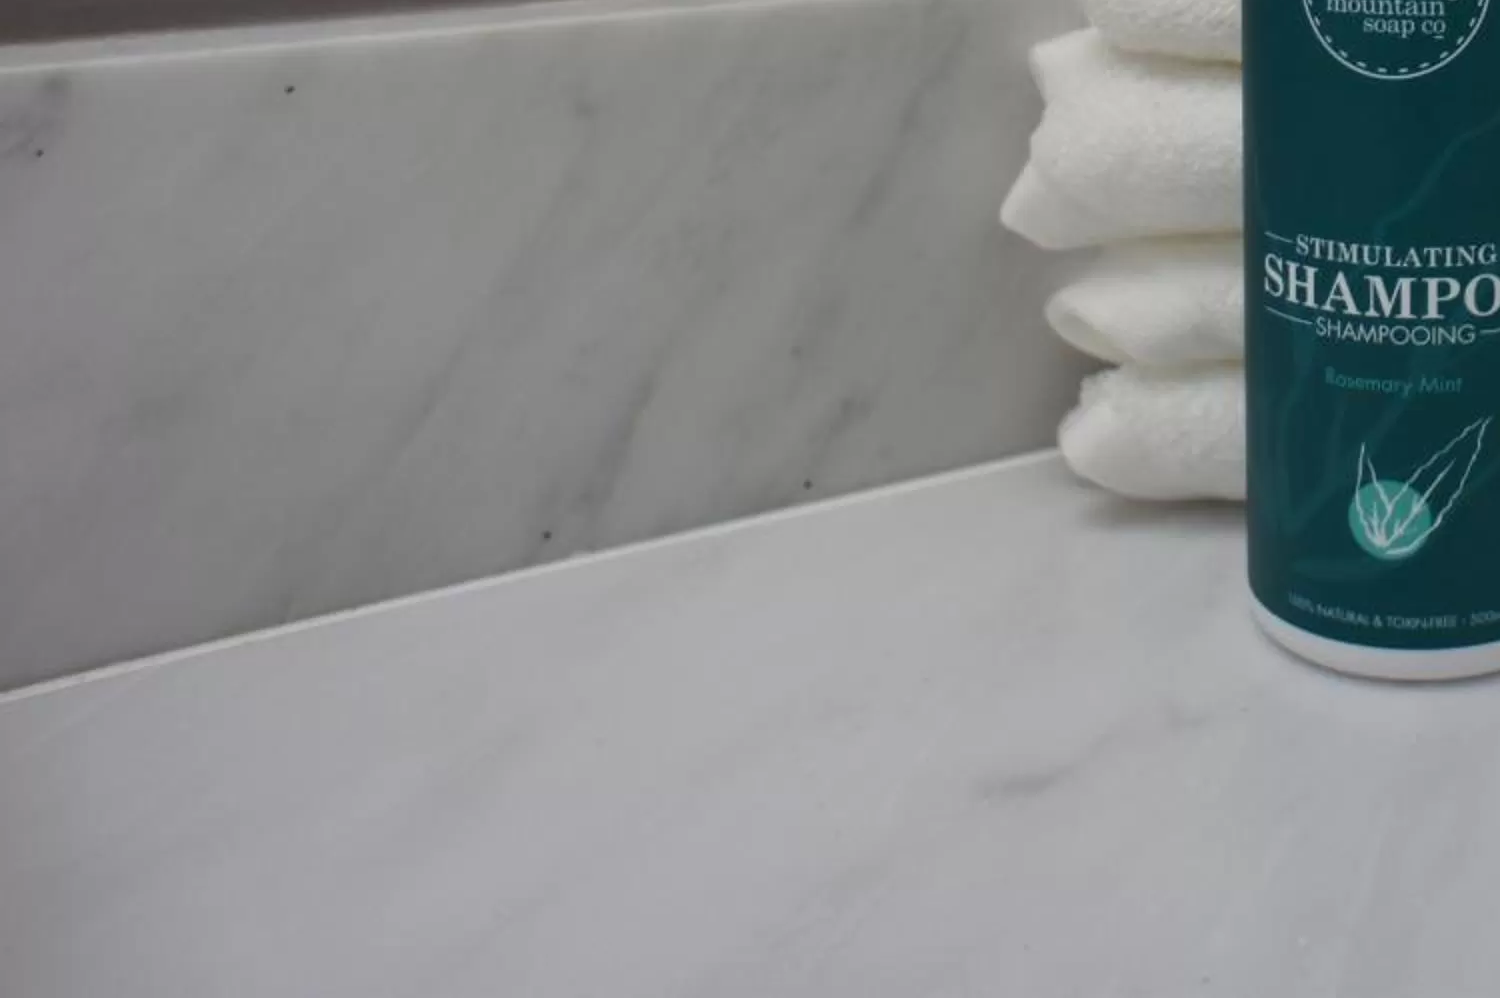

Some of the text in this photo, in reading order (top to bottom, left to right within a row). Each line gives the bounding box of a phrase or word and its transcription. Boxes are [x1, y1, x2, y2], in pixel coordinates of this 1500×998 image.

[1363, 17, 1446, 39] soap co
[1295, 233, 1498, 268] STIMULATING
[1315, 315, 1476, 346] SHAMPOOING
[1324, 366, 1463, 398] Rosemary Mint
[1316, 603, 1370, 626] NATURAL
[1372, 614, 1384, 628] &
